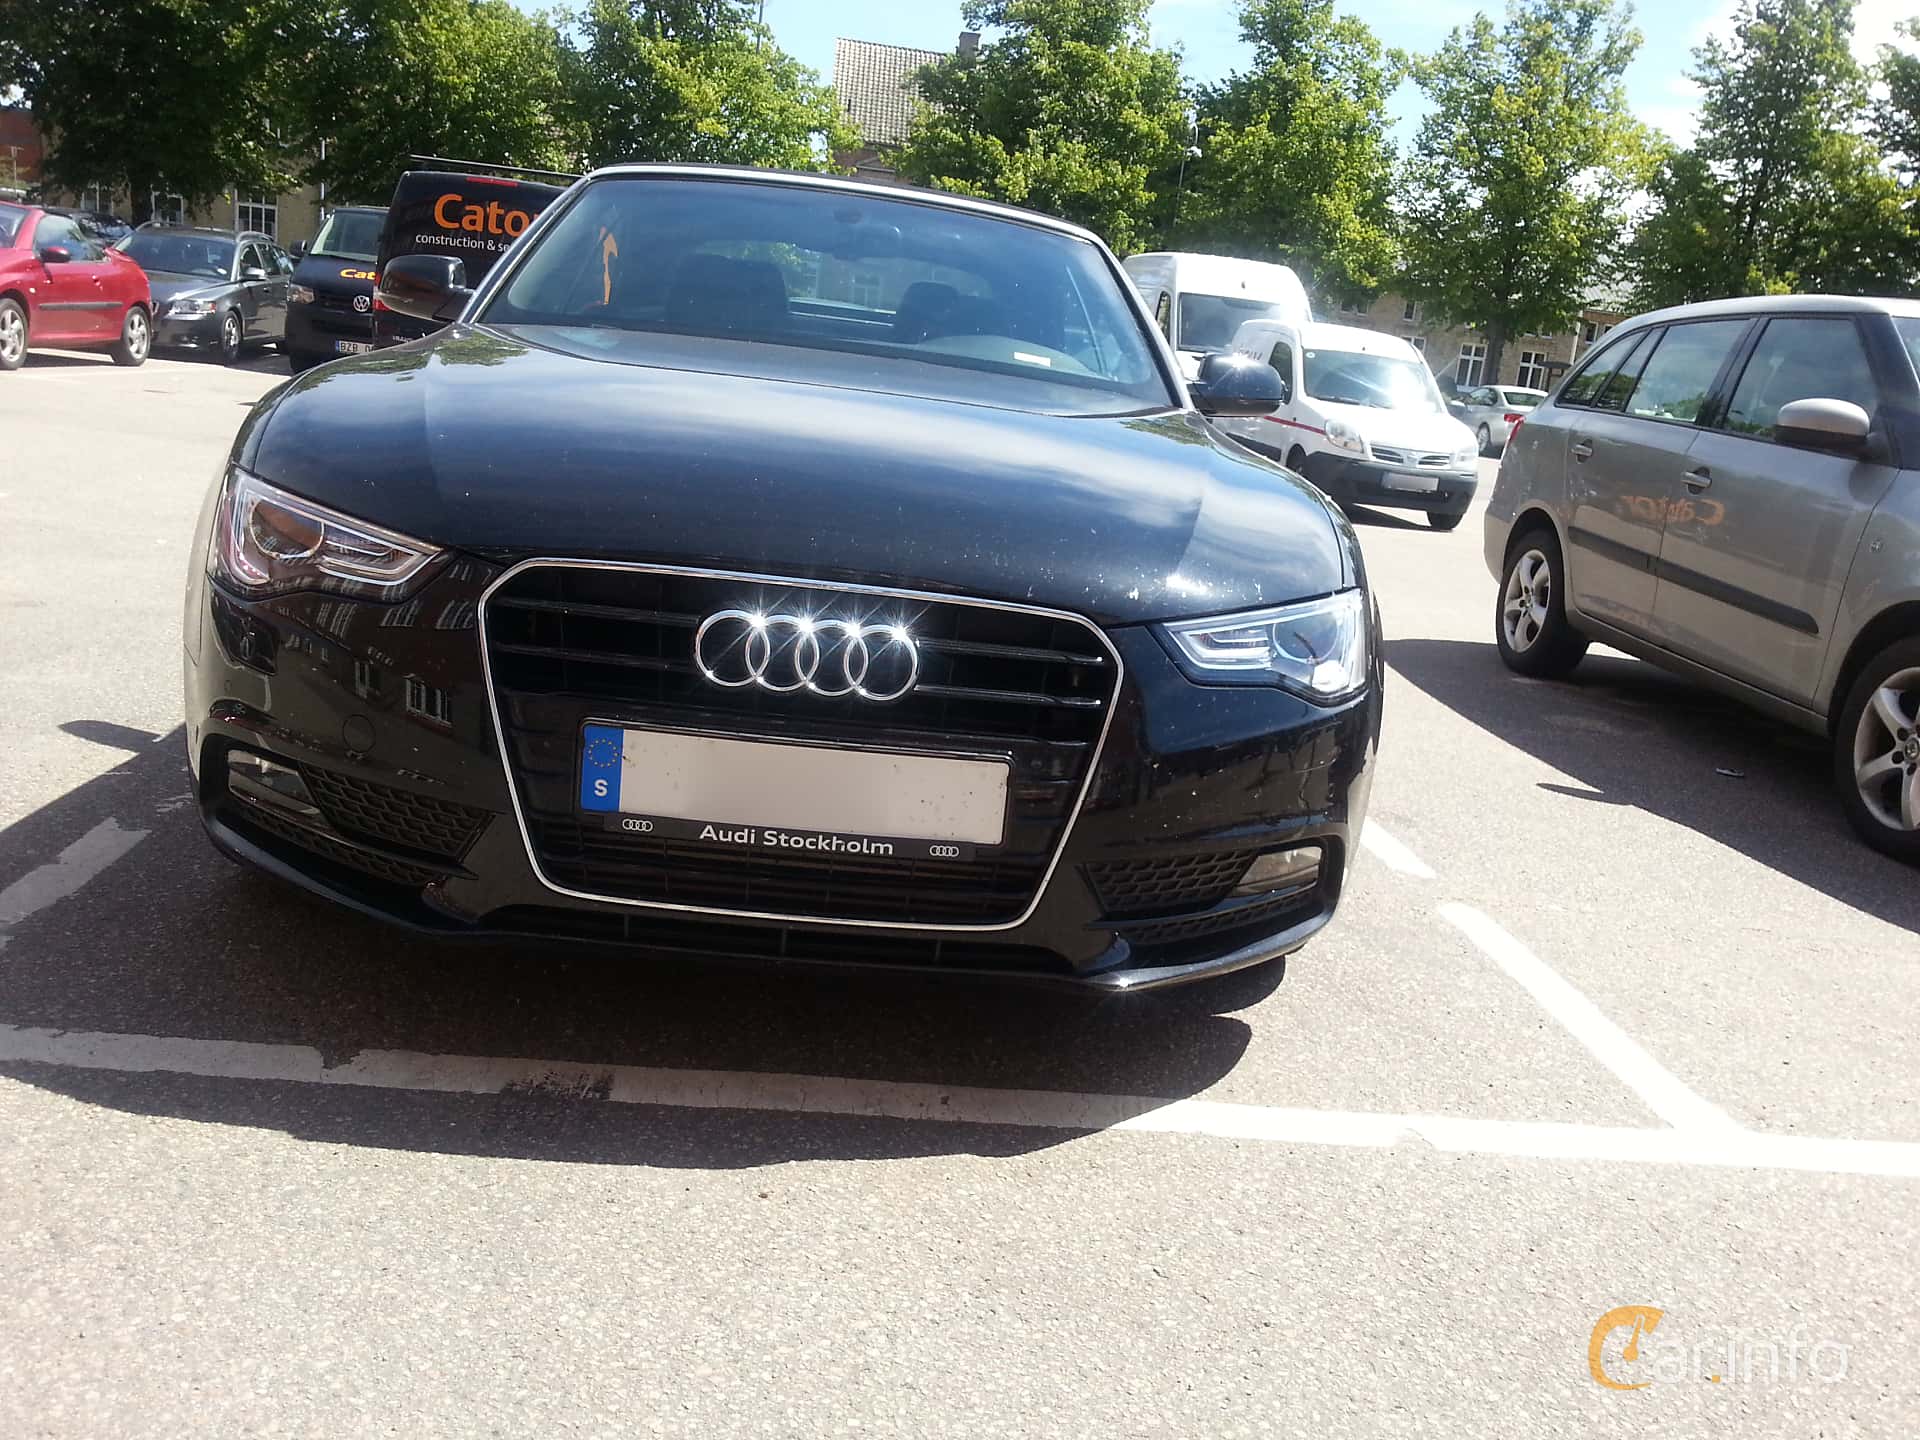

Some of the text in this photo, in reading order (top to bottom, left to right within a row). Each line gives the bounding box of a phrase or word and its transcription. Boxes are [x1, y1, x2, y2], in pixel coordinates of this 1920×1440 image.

[434, 193, 540, 237] Cato
[415, 234, 485, 249] construction
[486, 239, 496, 251] &
[594, 779, 608, 796] S
[700, 824, 894, 855] Audi Stockholm
